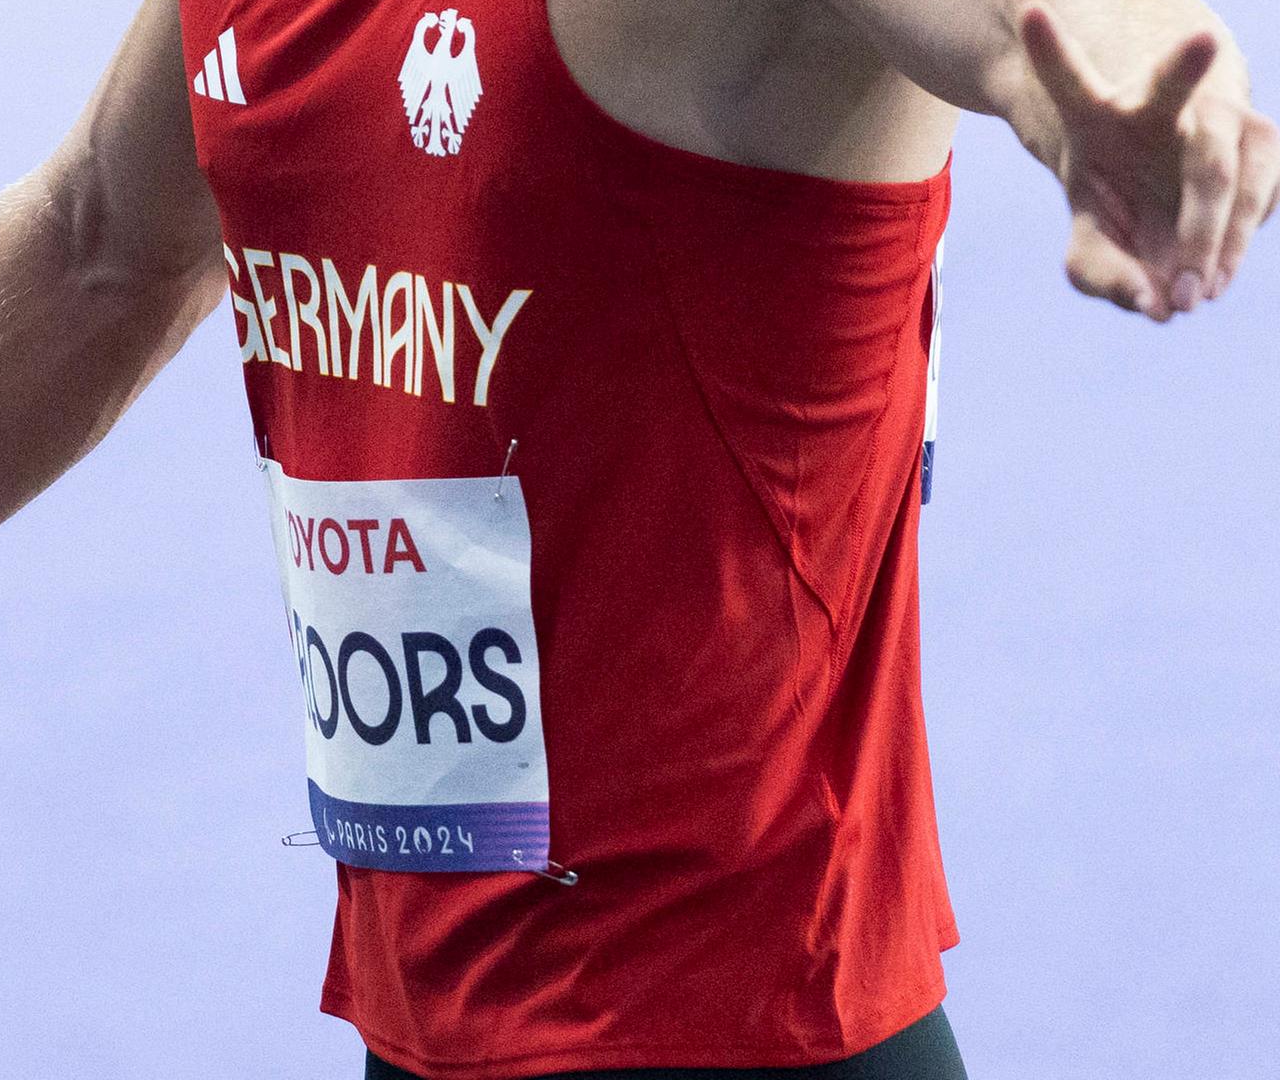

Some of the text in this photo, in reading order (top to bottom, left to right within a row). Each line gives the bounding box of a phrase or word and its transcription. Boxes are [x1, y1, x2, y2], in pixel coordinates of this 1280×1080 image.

[223, 242, 533, 406] GERMANY
[285, 508, 427, 575] OYOTA
[396, 824, 474, 855] 2024
